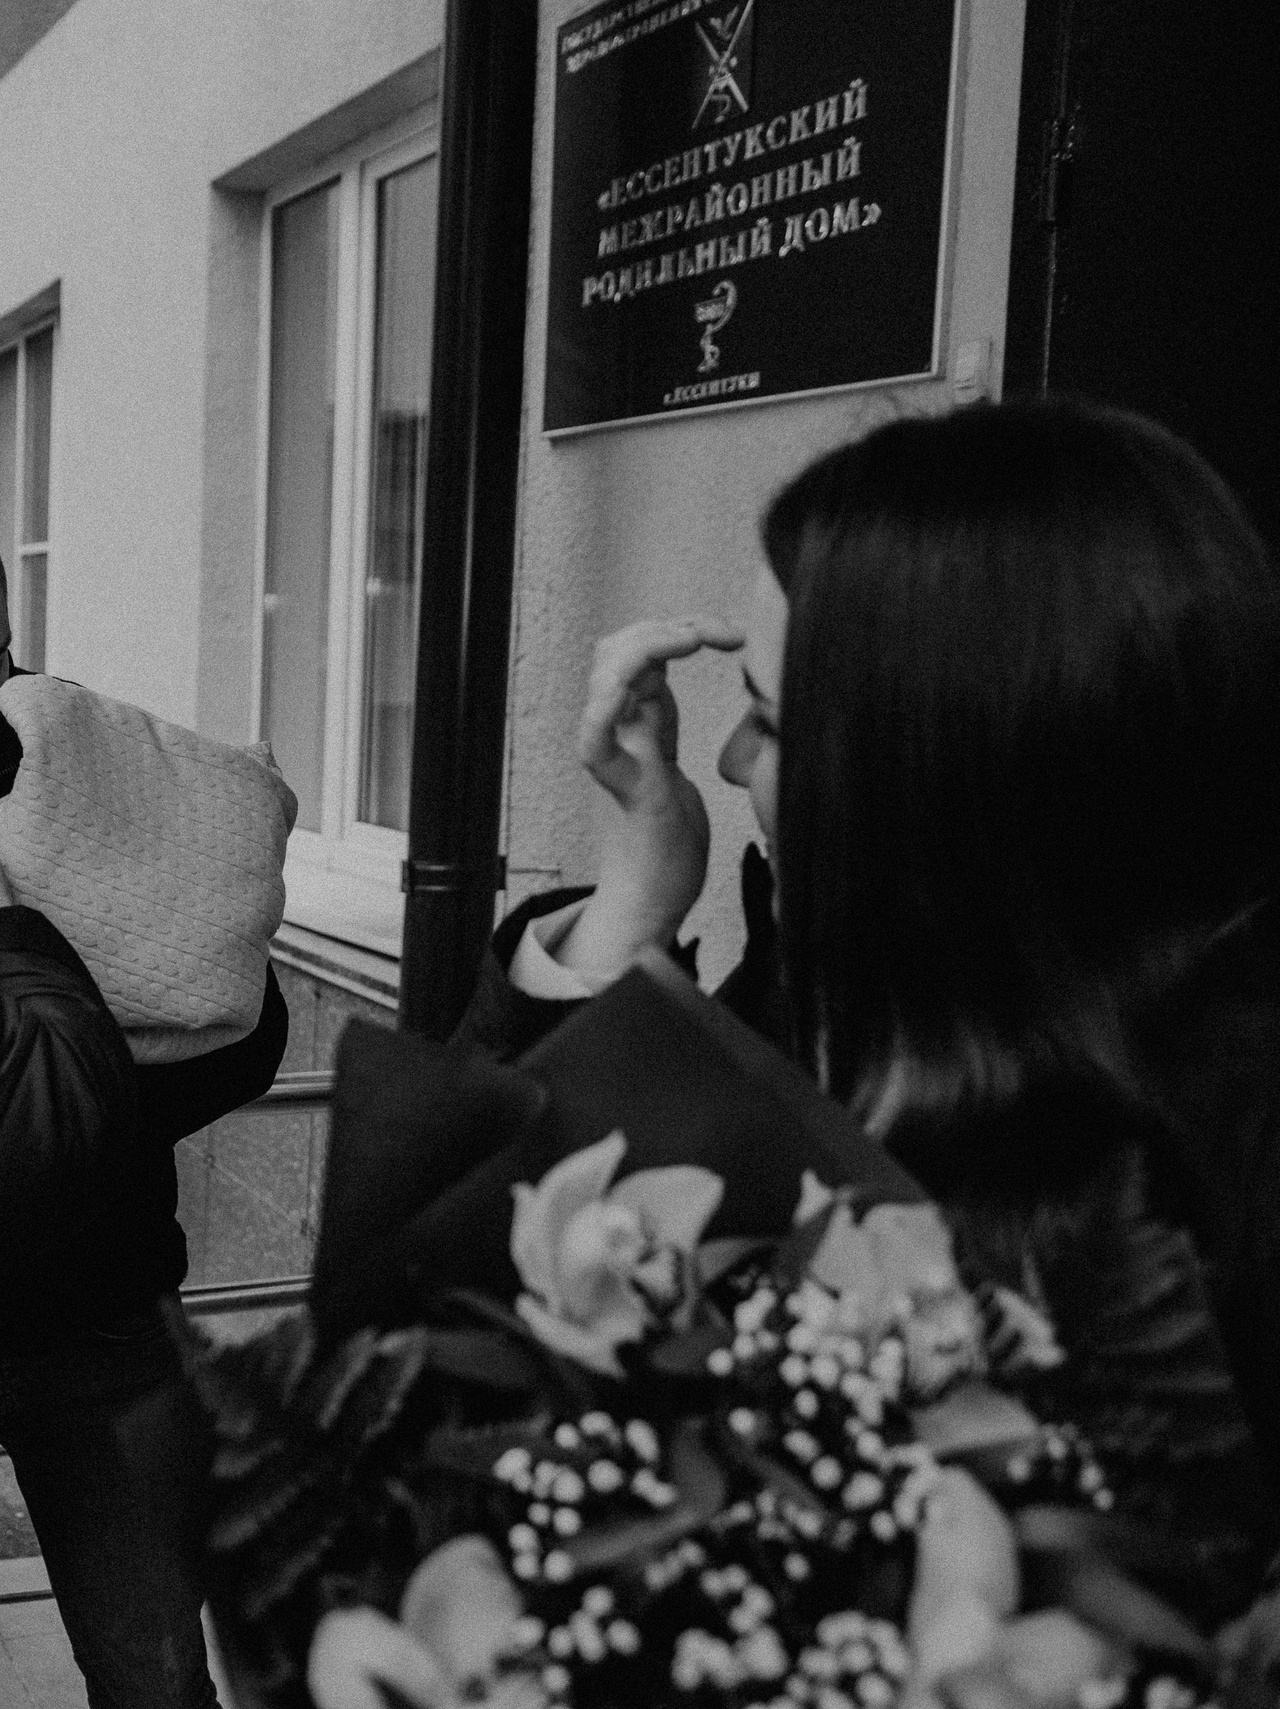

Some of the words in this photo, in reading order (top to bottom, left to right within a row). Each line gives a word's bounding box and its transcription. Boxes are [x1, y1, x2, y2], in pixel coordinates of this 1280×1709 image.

[582, 217, 773, 308] РОДИЛЬНЫЙ
[779, 197, 883, 257] ДОМ»
[598, 136, 863, 259] МЕЖРАЙОННЫЙ
